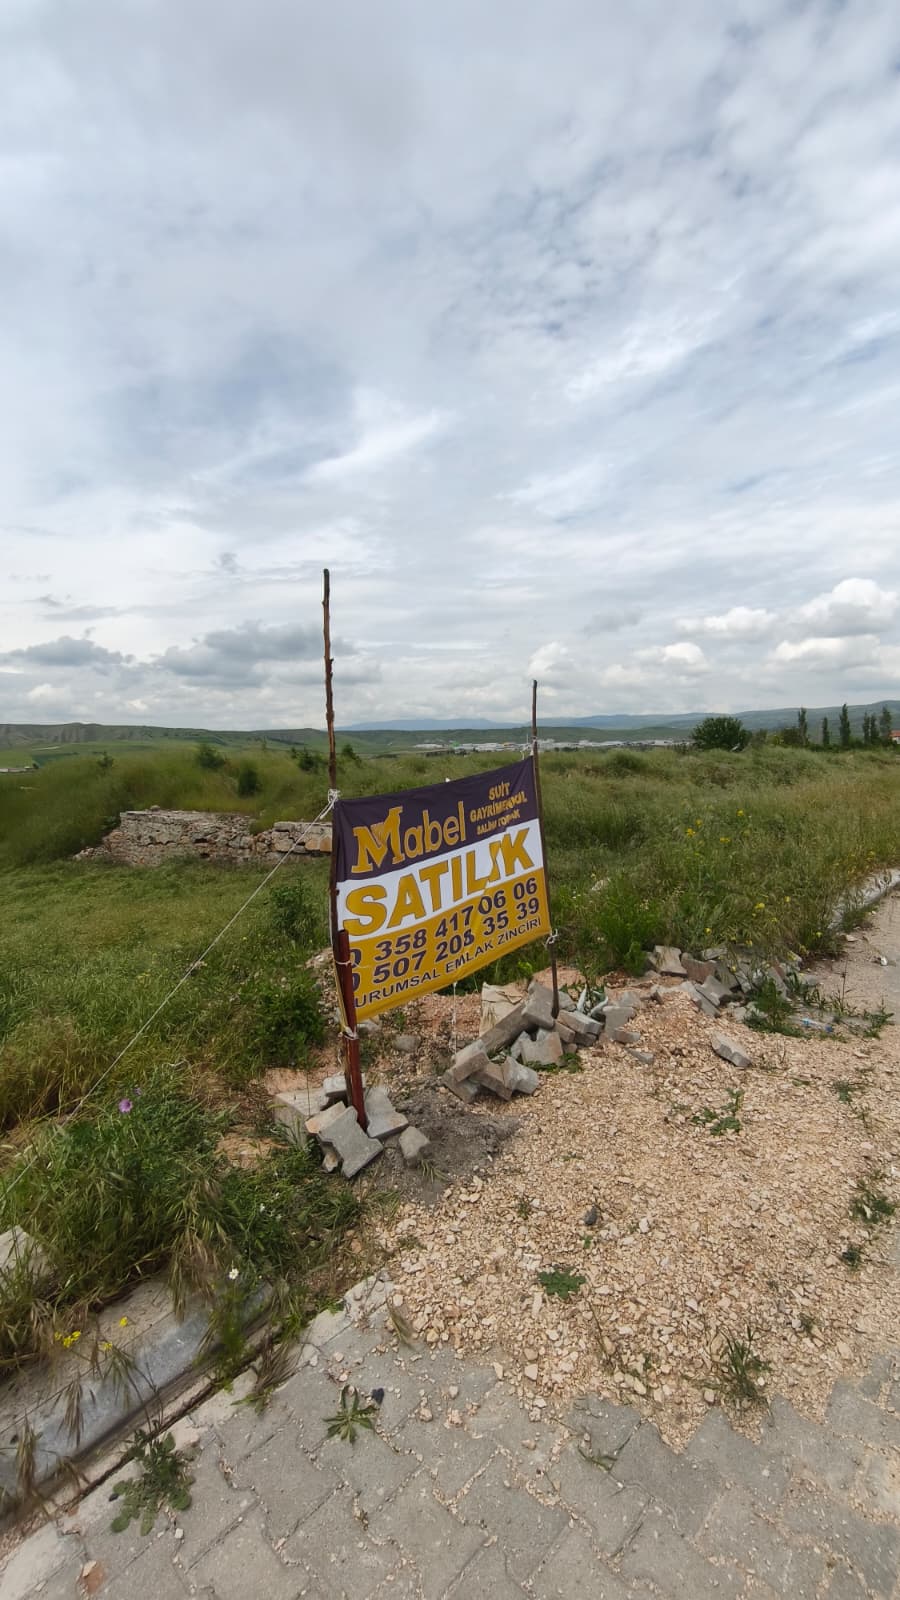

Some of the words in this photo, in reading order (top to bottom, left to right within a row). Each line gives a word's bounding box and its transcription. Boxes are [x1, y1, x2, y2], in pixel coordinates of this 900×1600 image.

[351, 800, 466, 874] Mabel
[343, 828, 535, 936] SATILIK
[374, 928, 427, 961] 358
[434, 905, 474, 938] 417
[478, 889, 507, 915] 06
[514, 877, 538, 900] 06
[354, 969, 440, 1008] URUMSAL
[446, 940, 494, 973] EMLAK
[373, 950, 427, 984] 507
[483, 910, 509, 936] 35
[516, 898, 539, 920] 39
